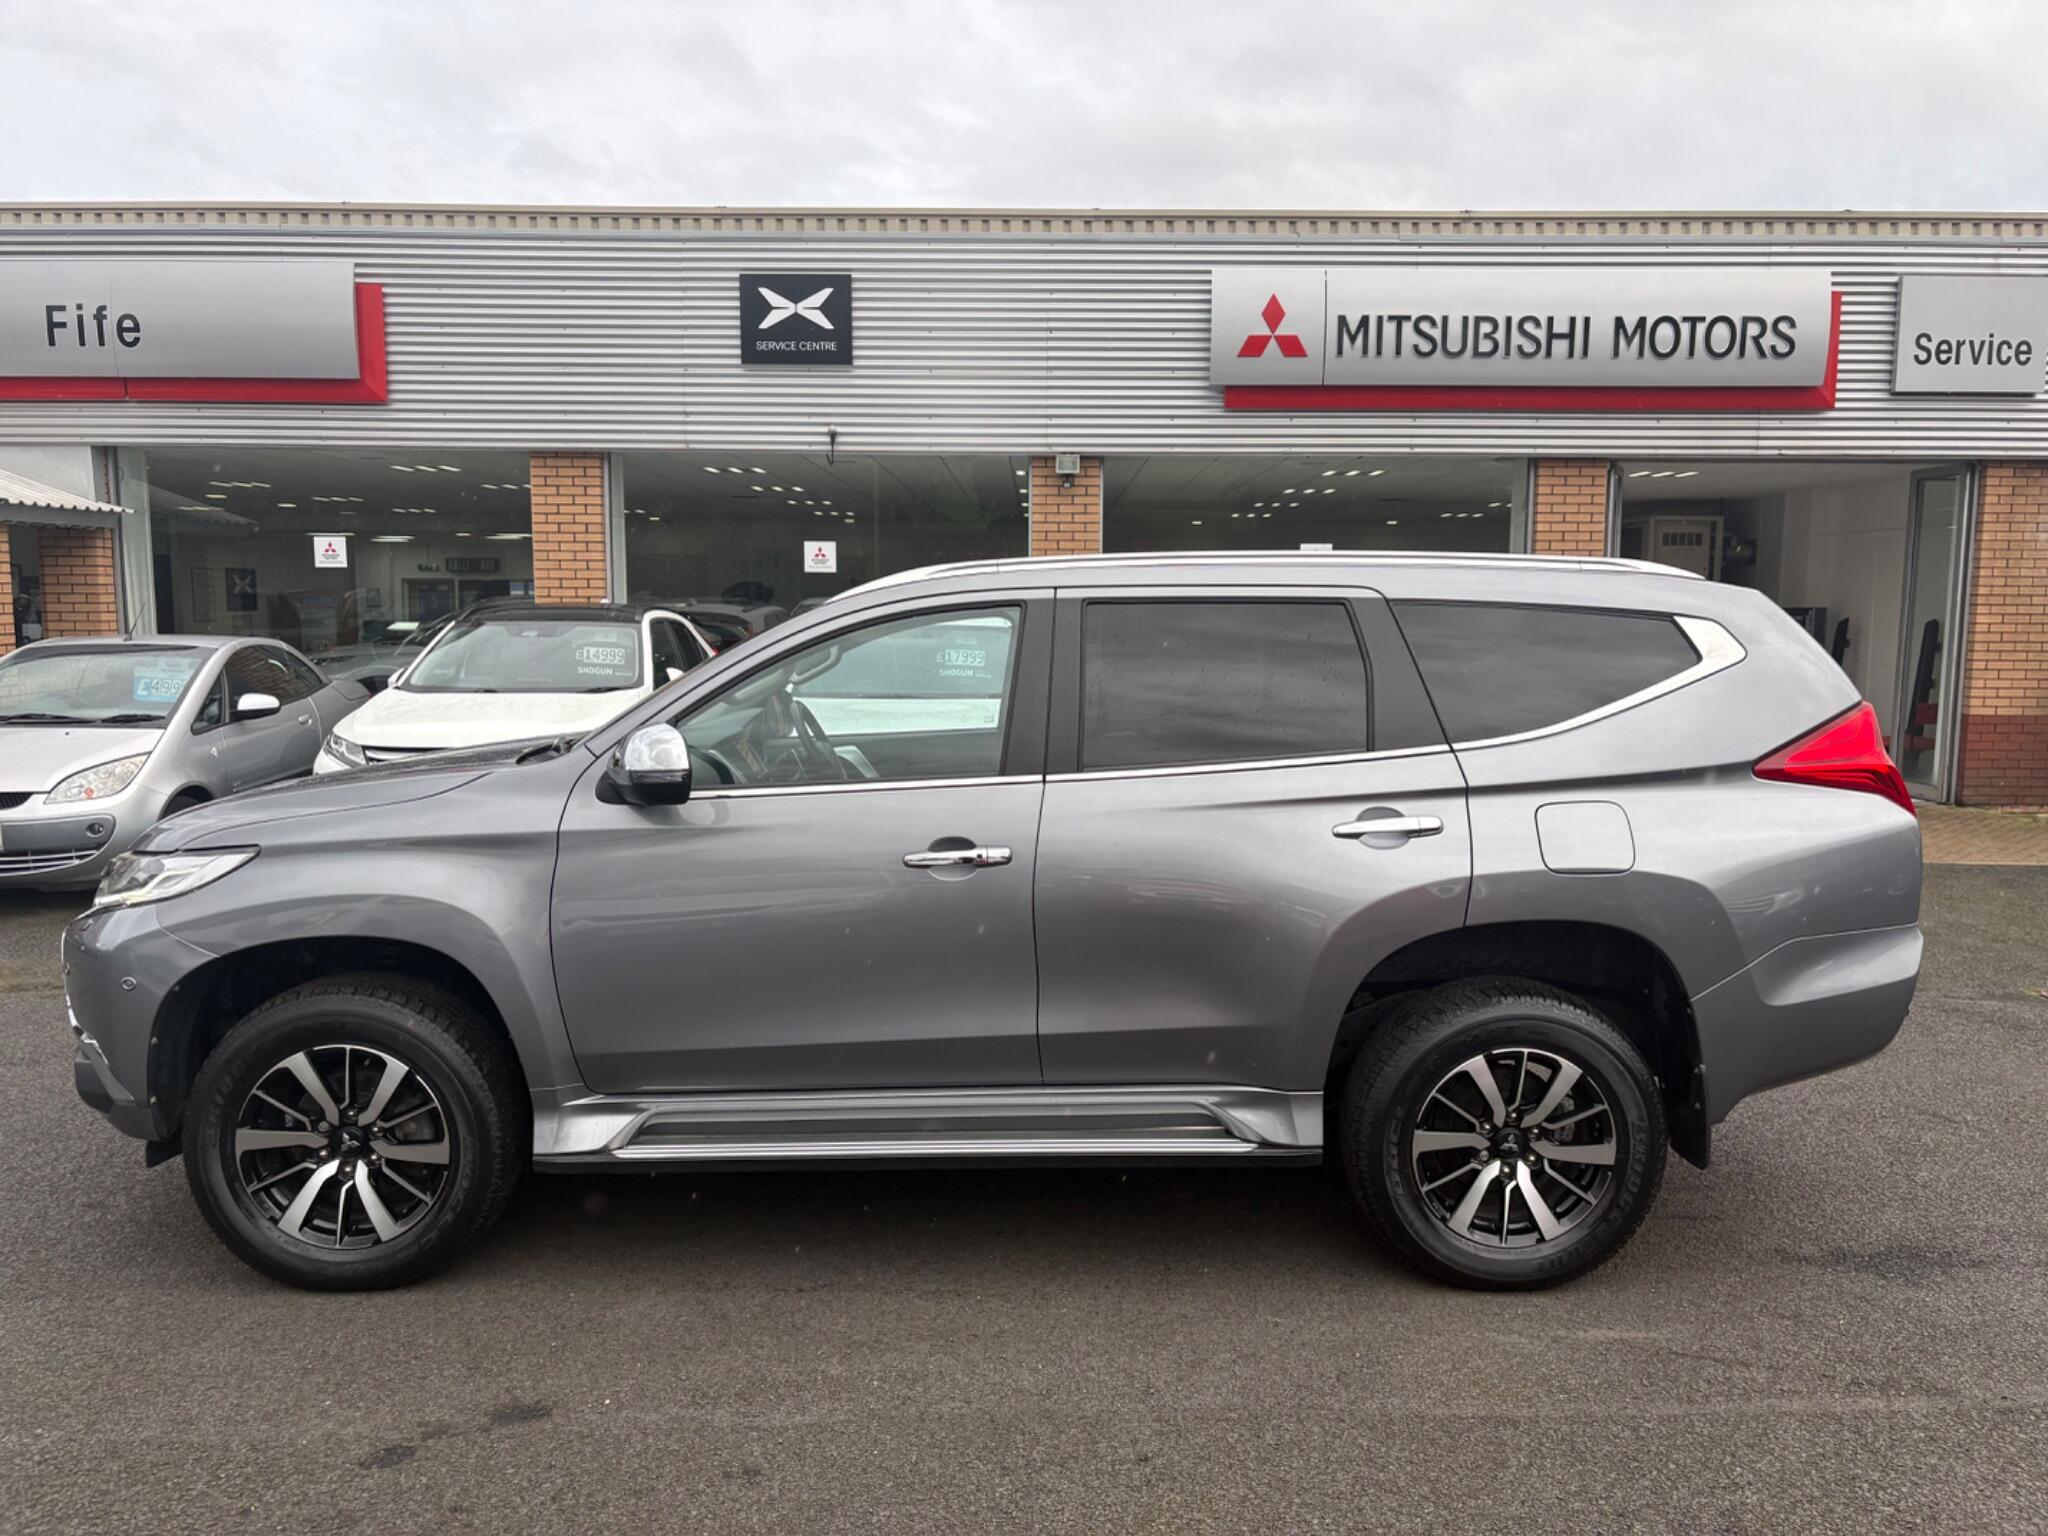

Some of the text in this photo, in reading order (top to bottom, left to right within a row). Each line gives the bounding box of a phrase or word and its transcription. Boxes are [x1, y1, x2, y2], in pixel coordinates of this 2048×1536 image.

[45, 303, 141, 348] Fife
[1336, 314, 1797, 360] MITSUBISHI MOTORS
[756, 341, 837, 351] SERVICE CENTRE
[1913, 332, 2033, 366] Service
